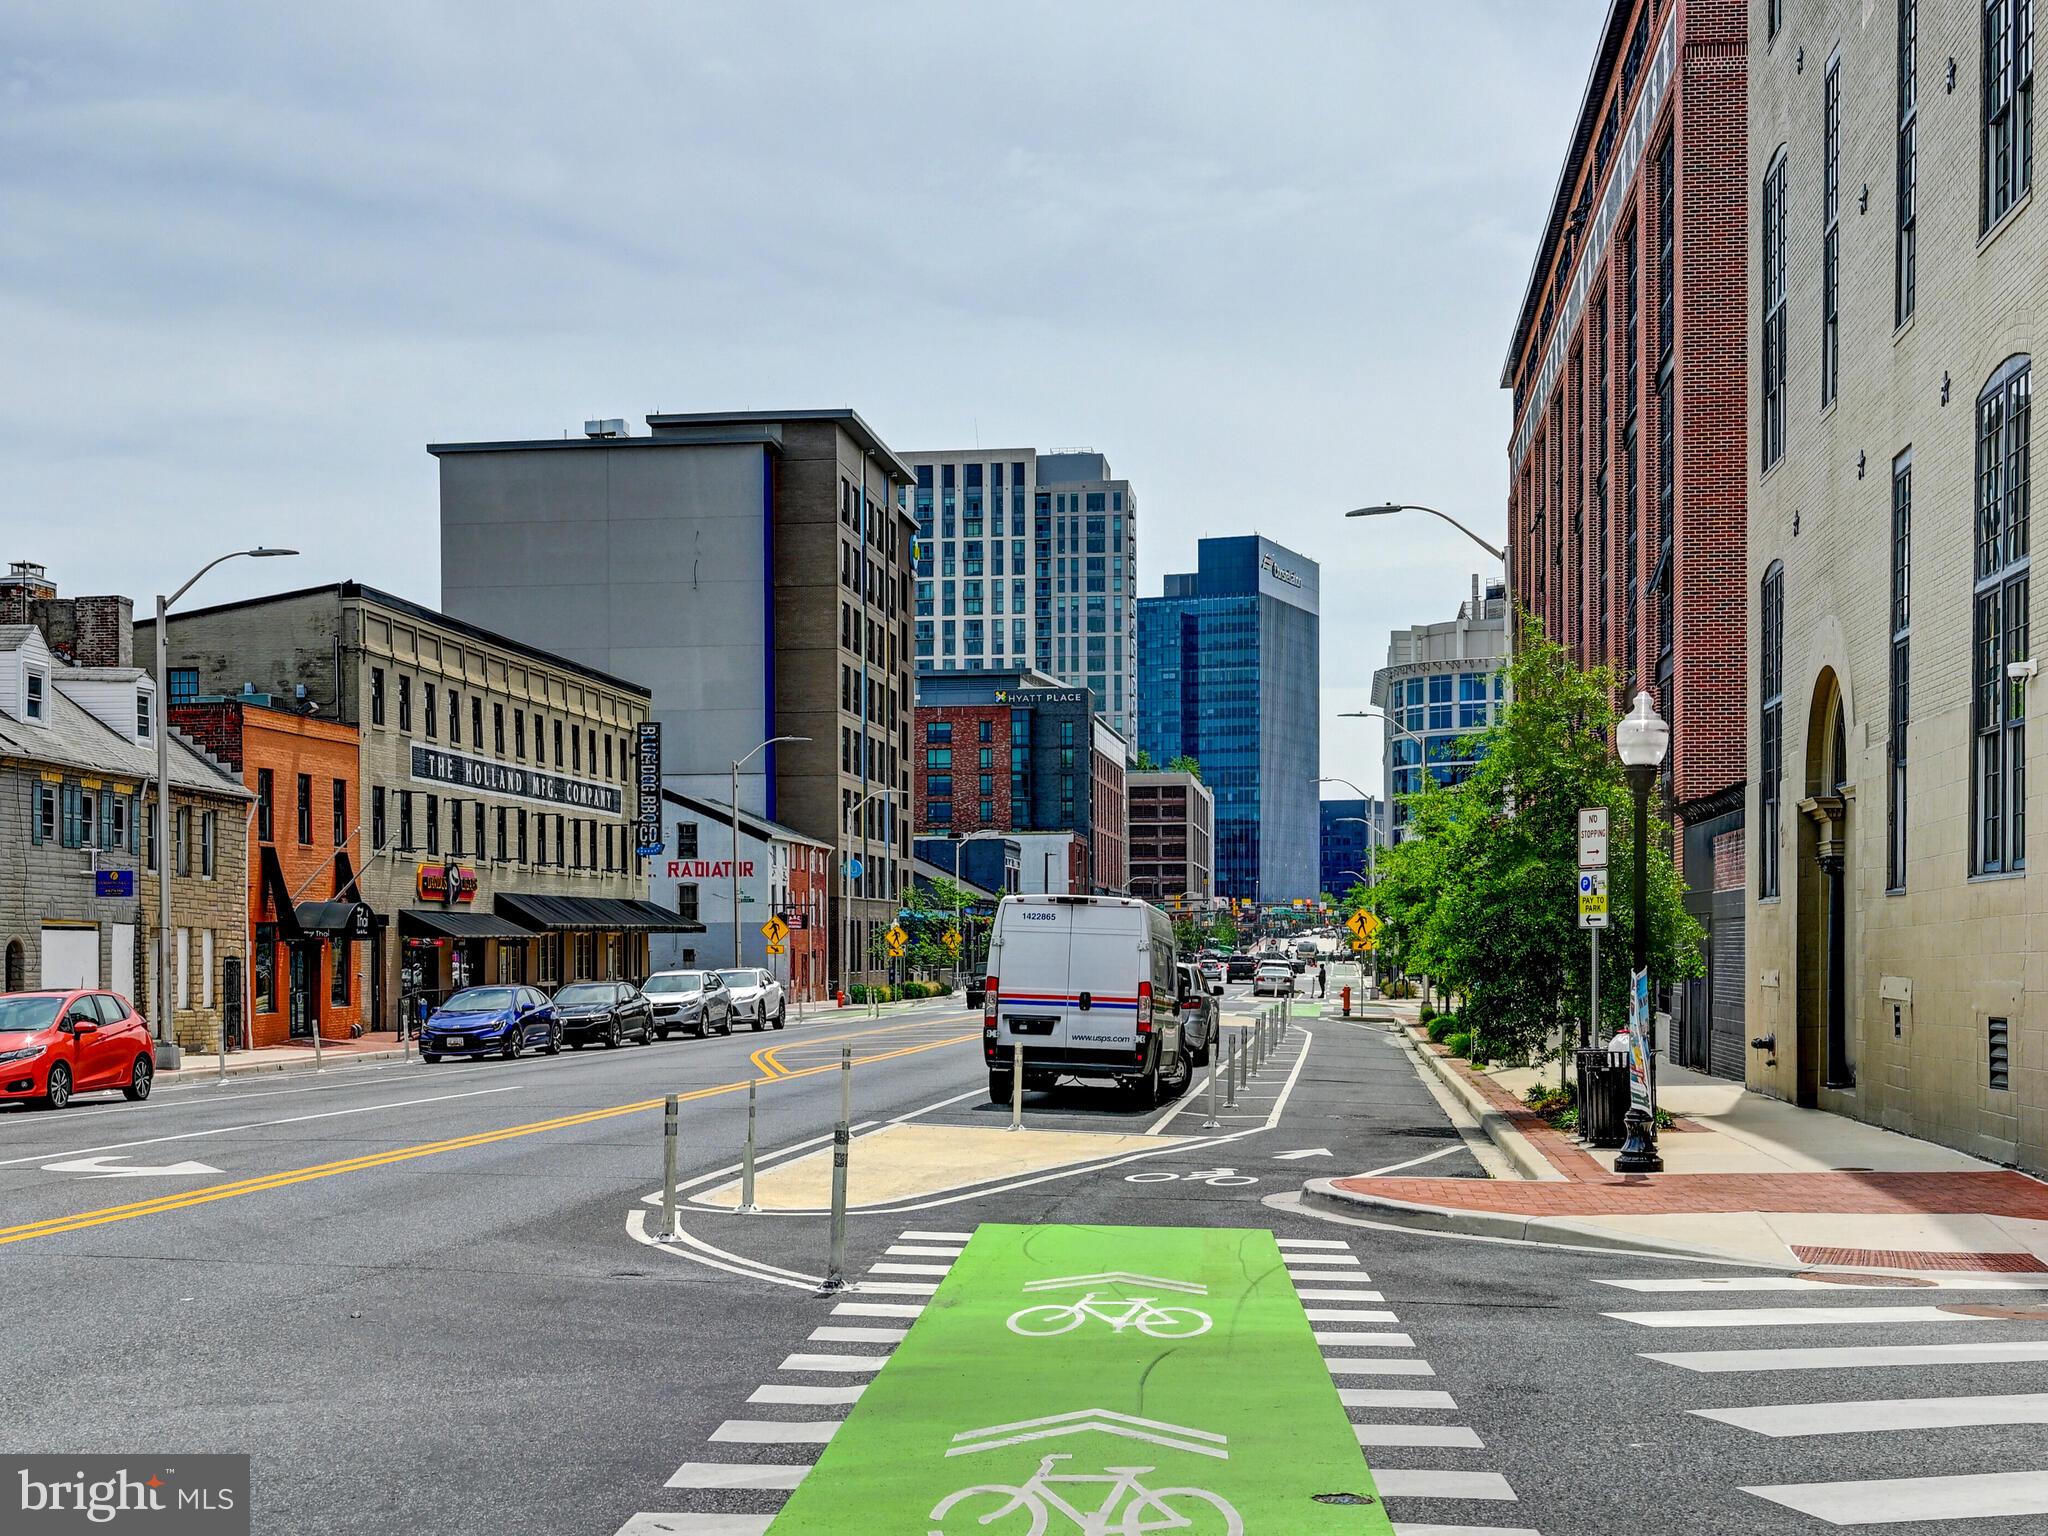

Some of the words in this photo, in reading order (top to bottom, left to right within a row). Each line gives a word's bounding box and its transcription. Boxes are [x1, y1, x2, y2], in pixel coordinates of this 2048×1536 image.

[1008, 694, 1042, 703] HYATT
[1046, 693, 1081, 702] PLACE
[640, 725, 658, 763] BLUE
[428, 754, 454, 779] THE
[465, 761, 522, 792] HOLLAND
[532, 776, 558, 798] MFG.
[566, 783, 612, 809] COMPANY
[640, 765, 657, 792] DOG
[639, 794, 657, 823] BBQ
[1588, 815, 1598, 823] NO
[1581, 829, 1606, 839] STOPPING
[1596, 896, 1604, 904] TO
[1585, 904, 1601, 913] PARK
[1022, 912, 1056, 921] 1422865
[1071, 1034, 1131, 1044] www.usps.com
